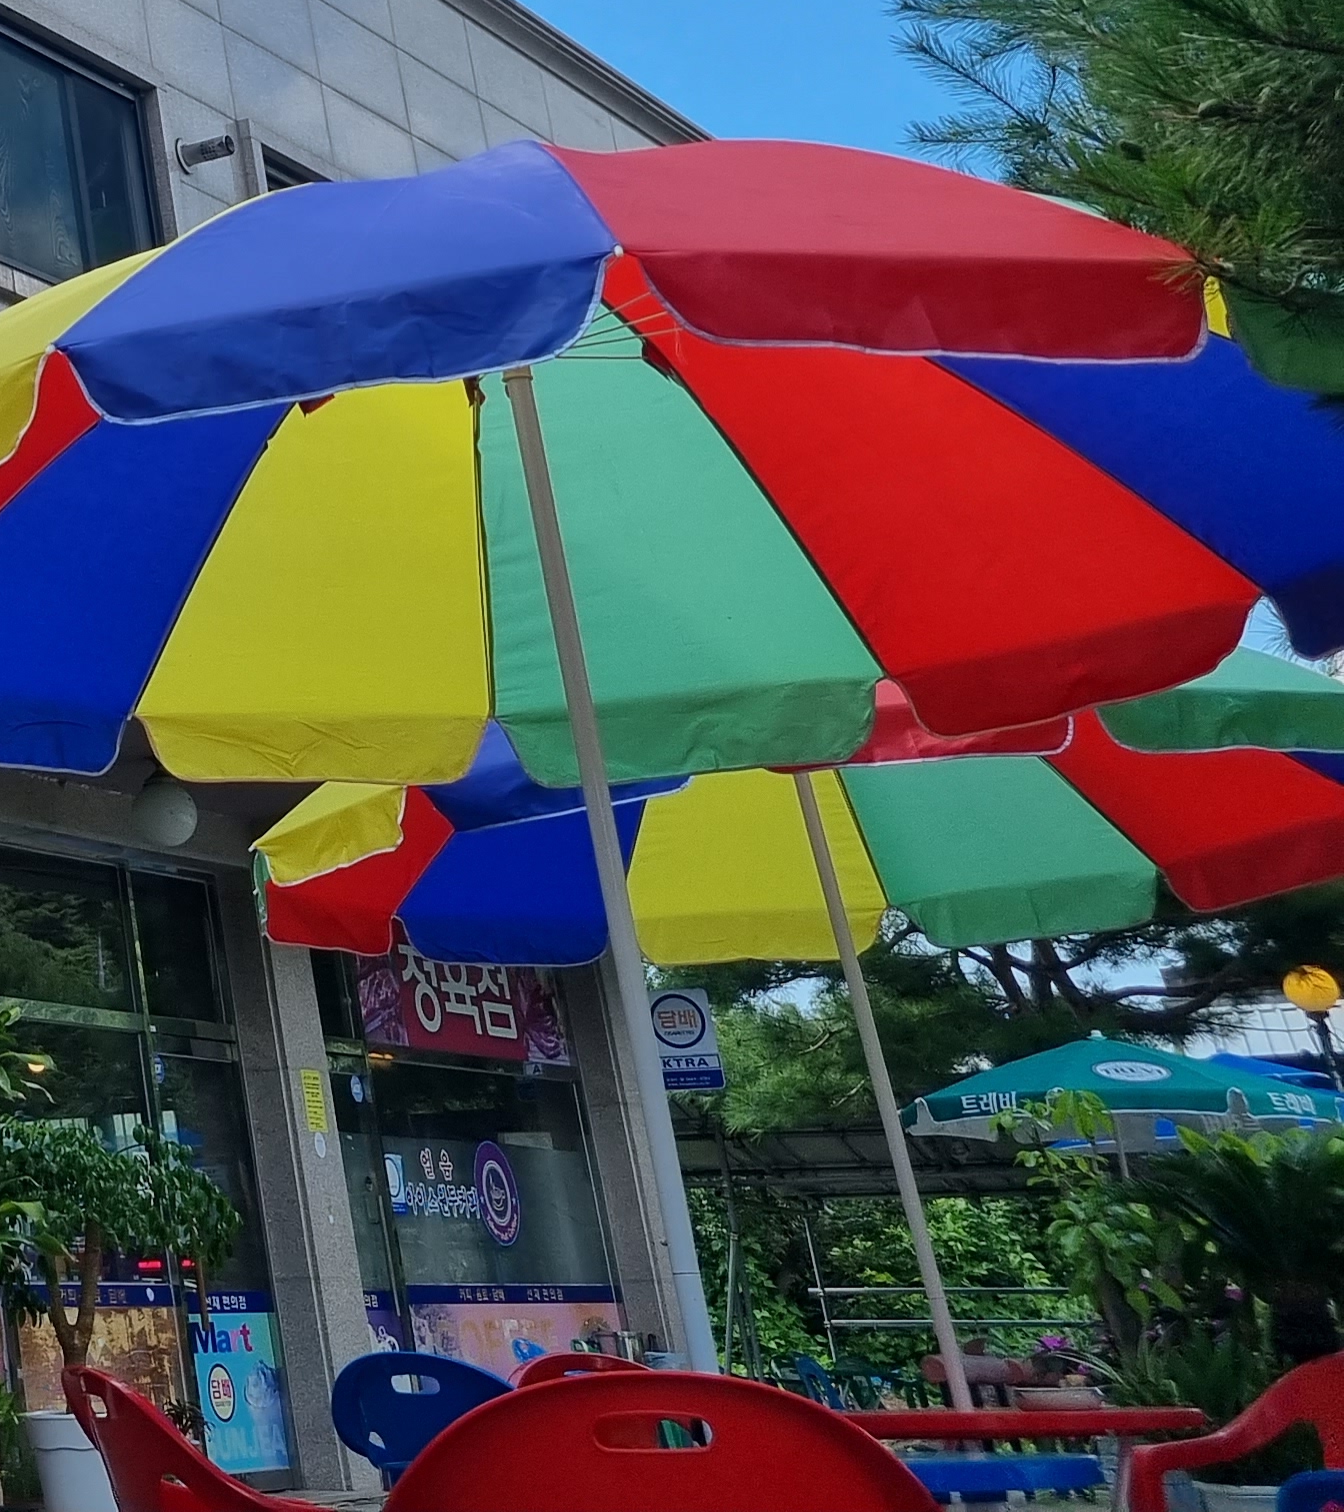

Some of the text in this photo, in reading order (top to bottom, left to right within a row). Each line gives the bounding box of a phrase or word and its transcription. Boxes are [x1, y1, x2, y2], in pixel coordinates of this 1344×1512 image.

[398, 944, 518, 1039] 정육점
[657, 1010, 698, 1029] 담배
[662, 1057, 709, 1068] KTRA
[961, 1091, 1017, 1115] 트레비
[222, 1295, 247, 1311] 편의점
[192, 1321, 254, 1354] Mart
